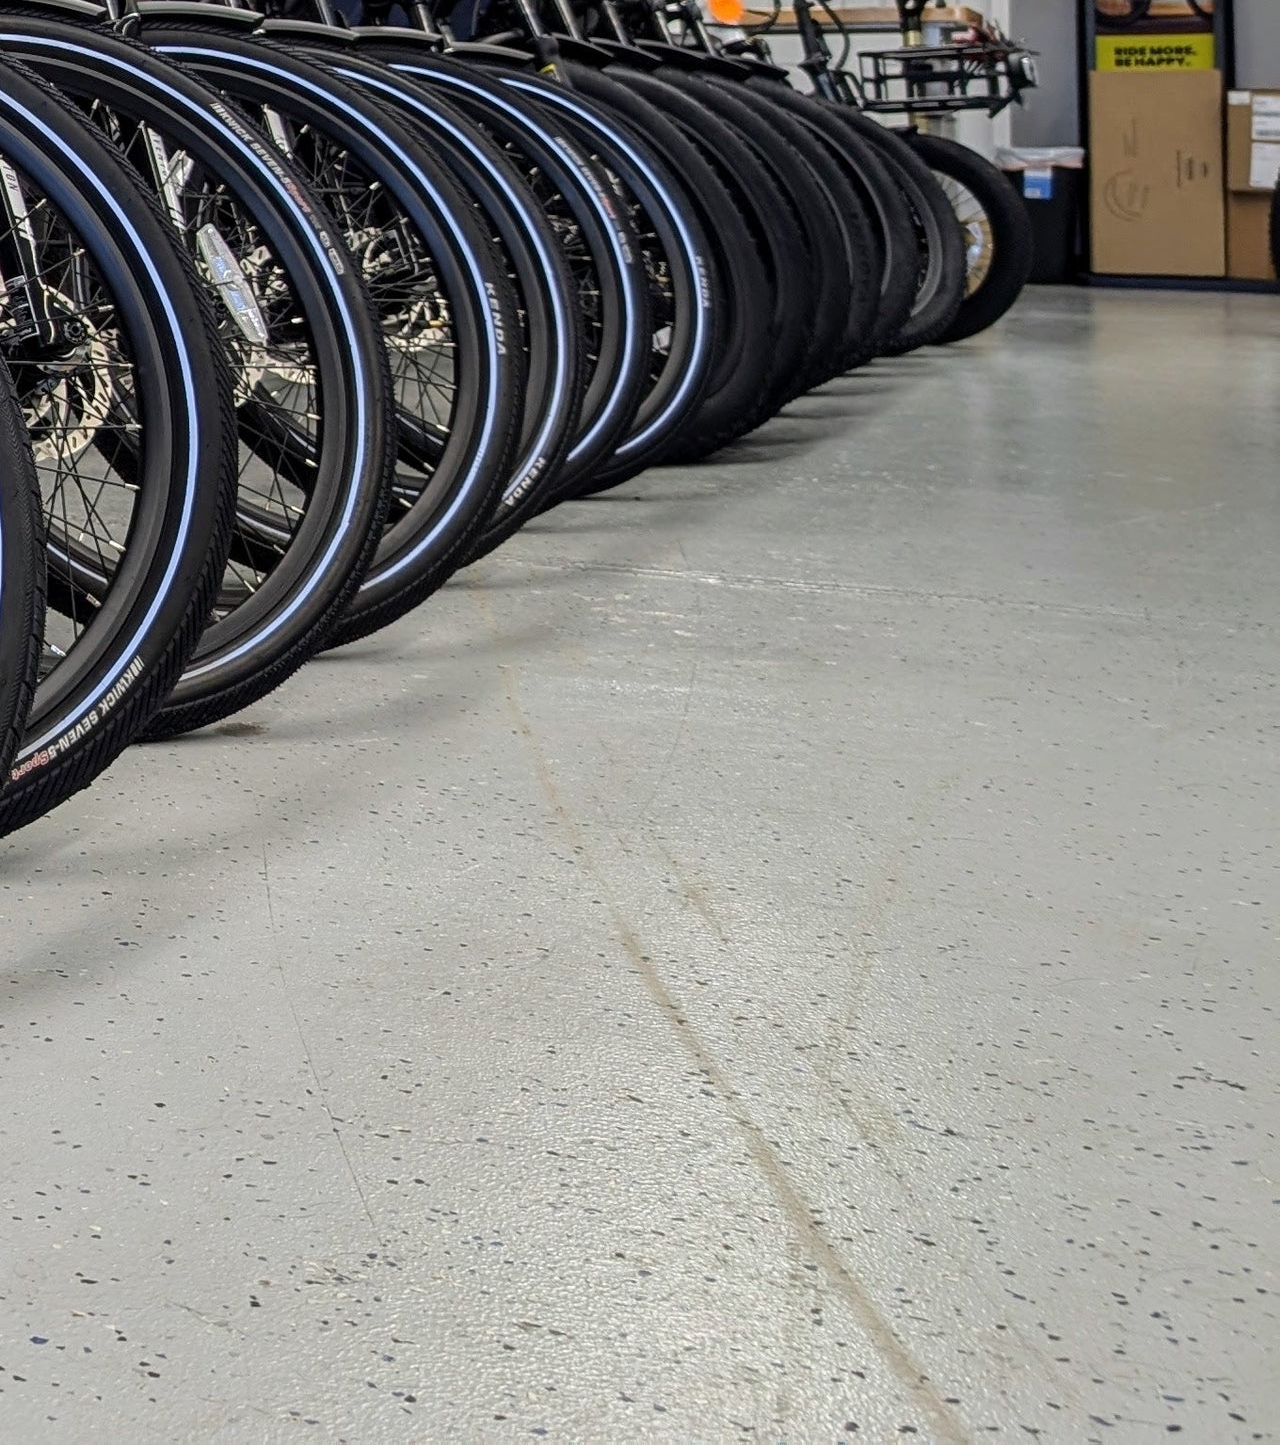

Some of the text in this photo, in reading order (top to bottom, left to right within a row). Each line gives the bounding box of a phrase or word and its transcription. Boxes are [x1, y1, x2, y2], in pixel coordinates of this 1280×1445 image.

[1114, 47, 1146, 55] RIDE
[1115, 57, 1192, 66] BE HAPPY.
[484, 282, 506, 354] KENDA
[504, 456, 546, 506] KENDA
